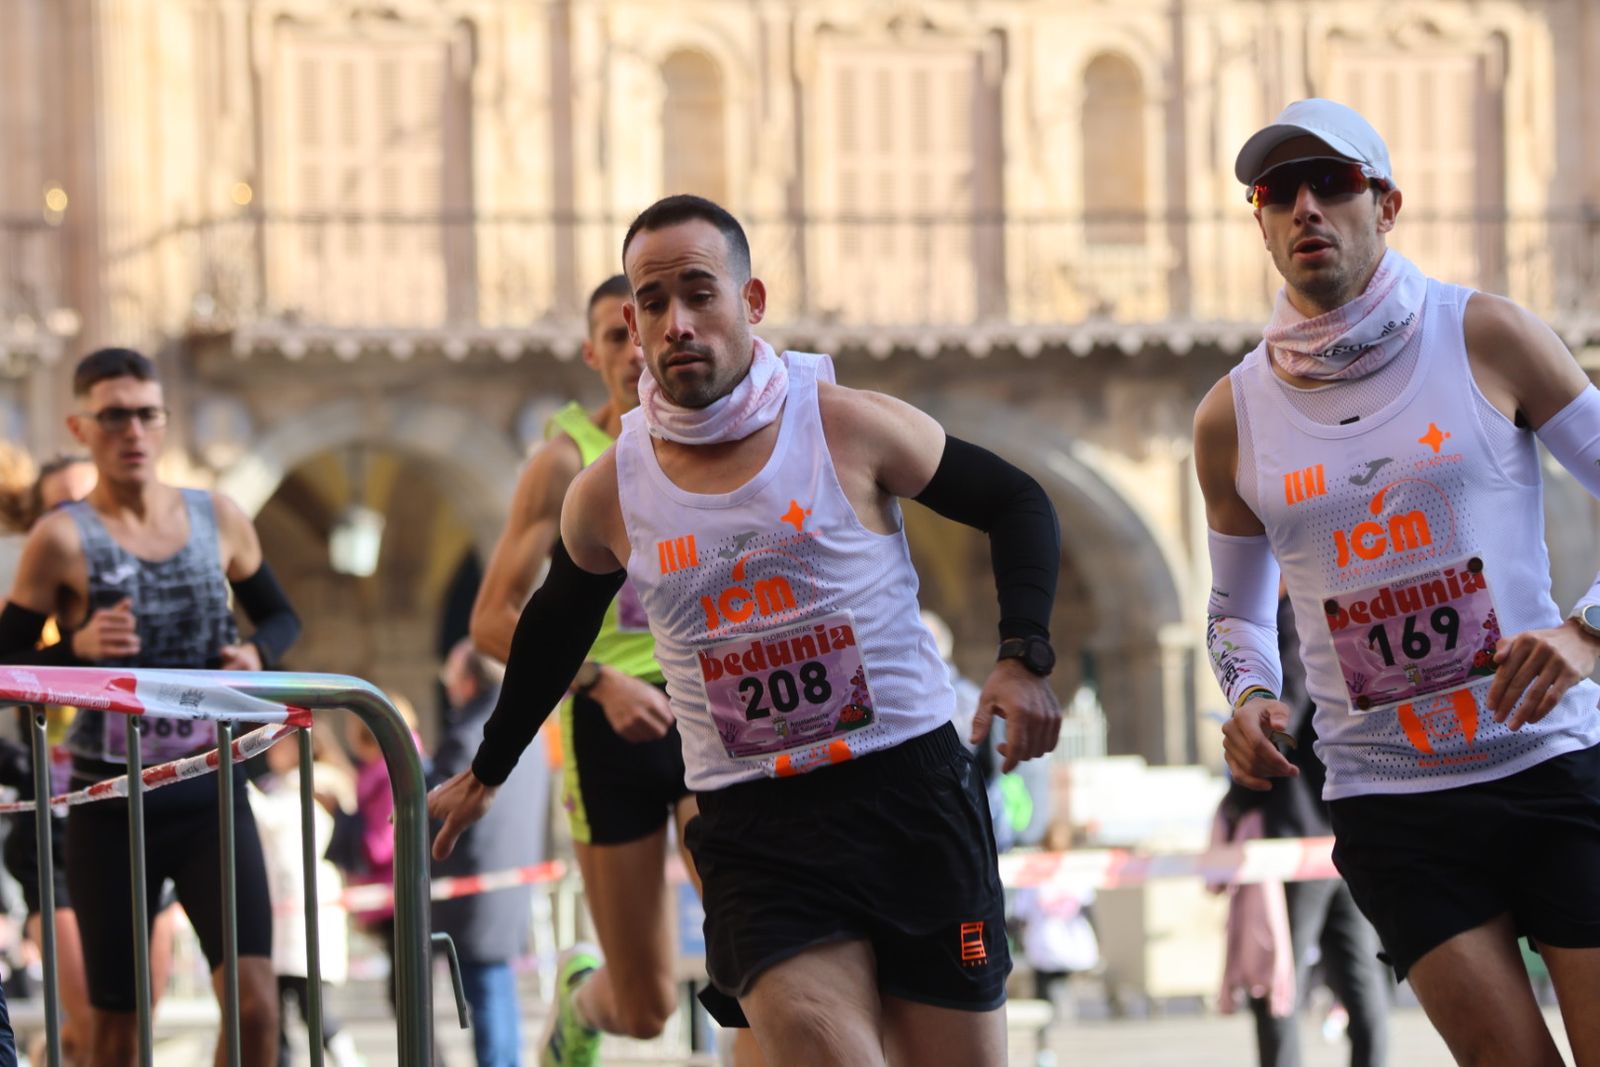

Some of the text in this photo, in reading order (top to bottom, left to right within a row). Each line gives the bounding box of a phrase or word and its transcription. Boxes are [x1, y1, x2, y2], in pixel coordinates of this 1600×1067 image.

[699, 623, 855, 682] bedunia
[1367, 606, 1460, 667] 169
[739, 662, 832, 721] 208
